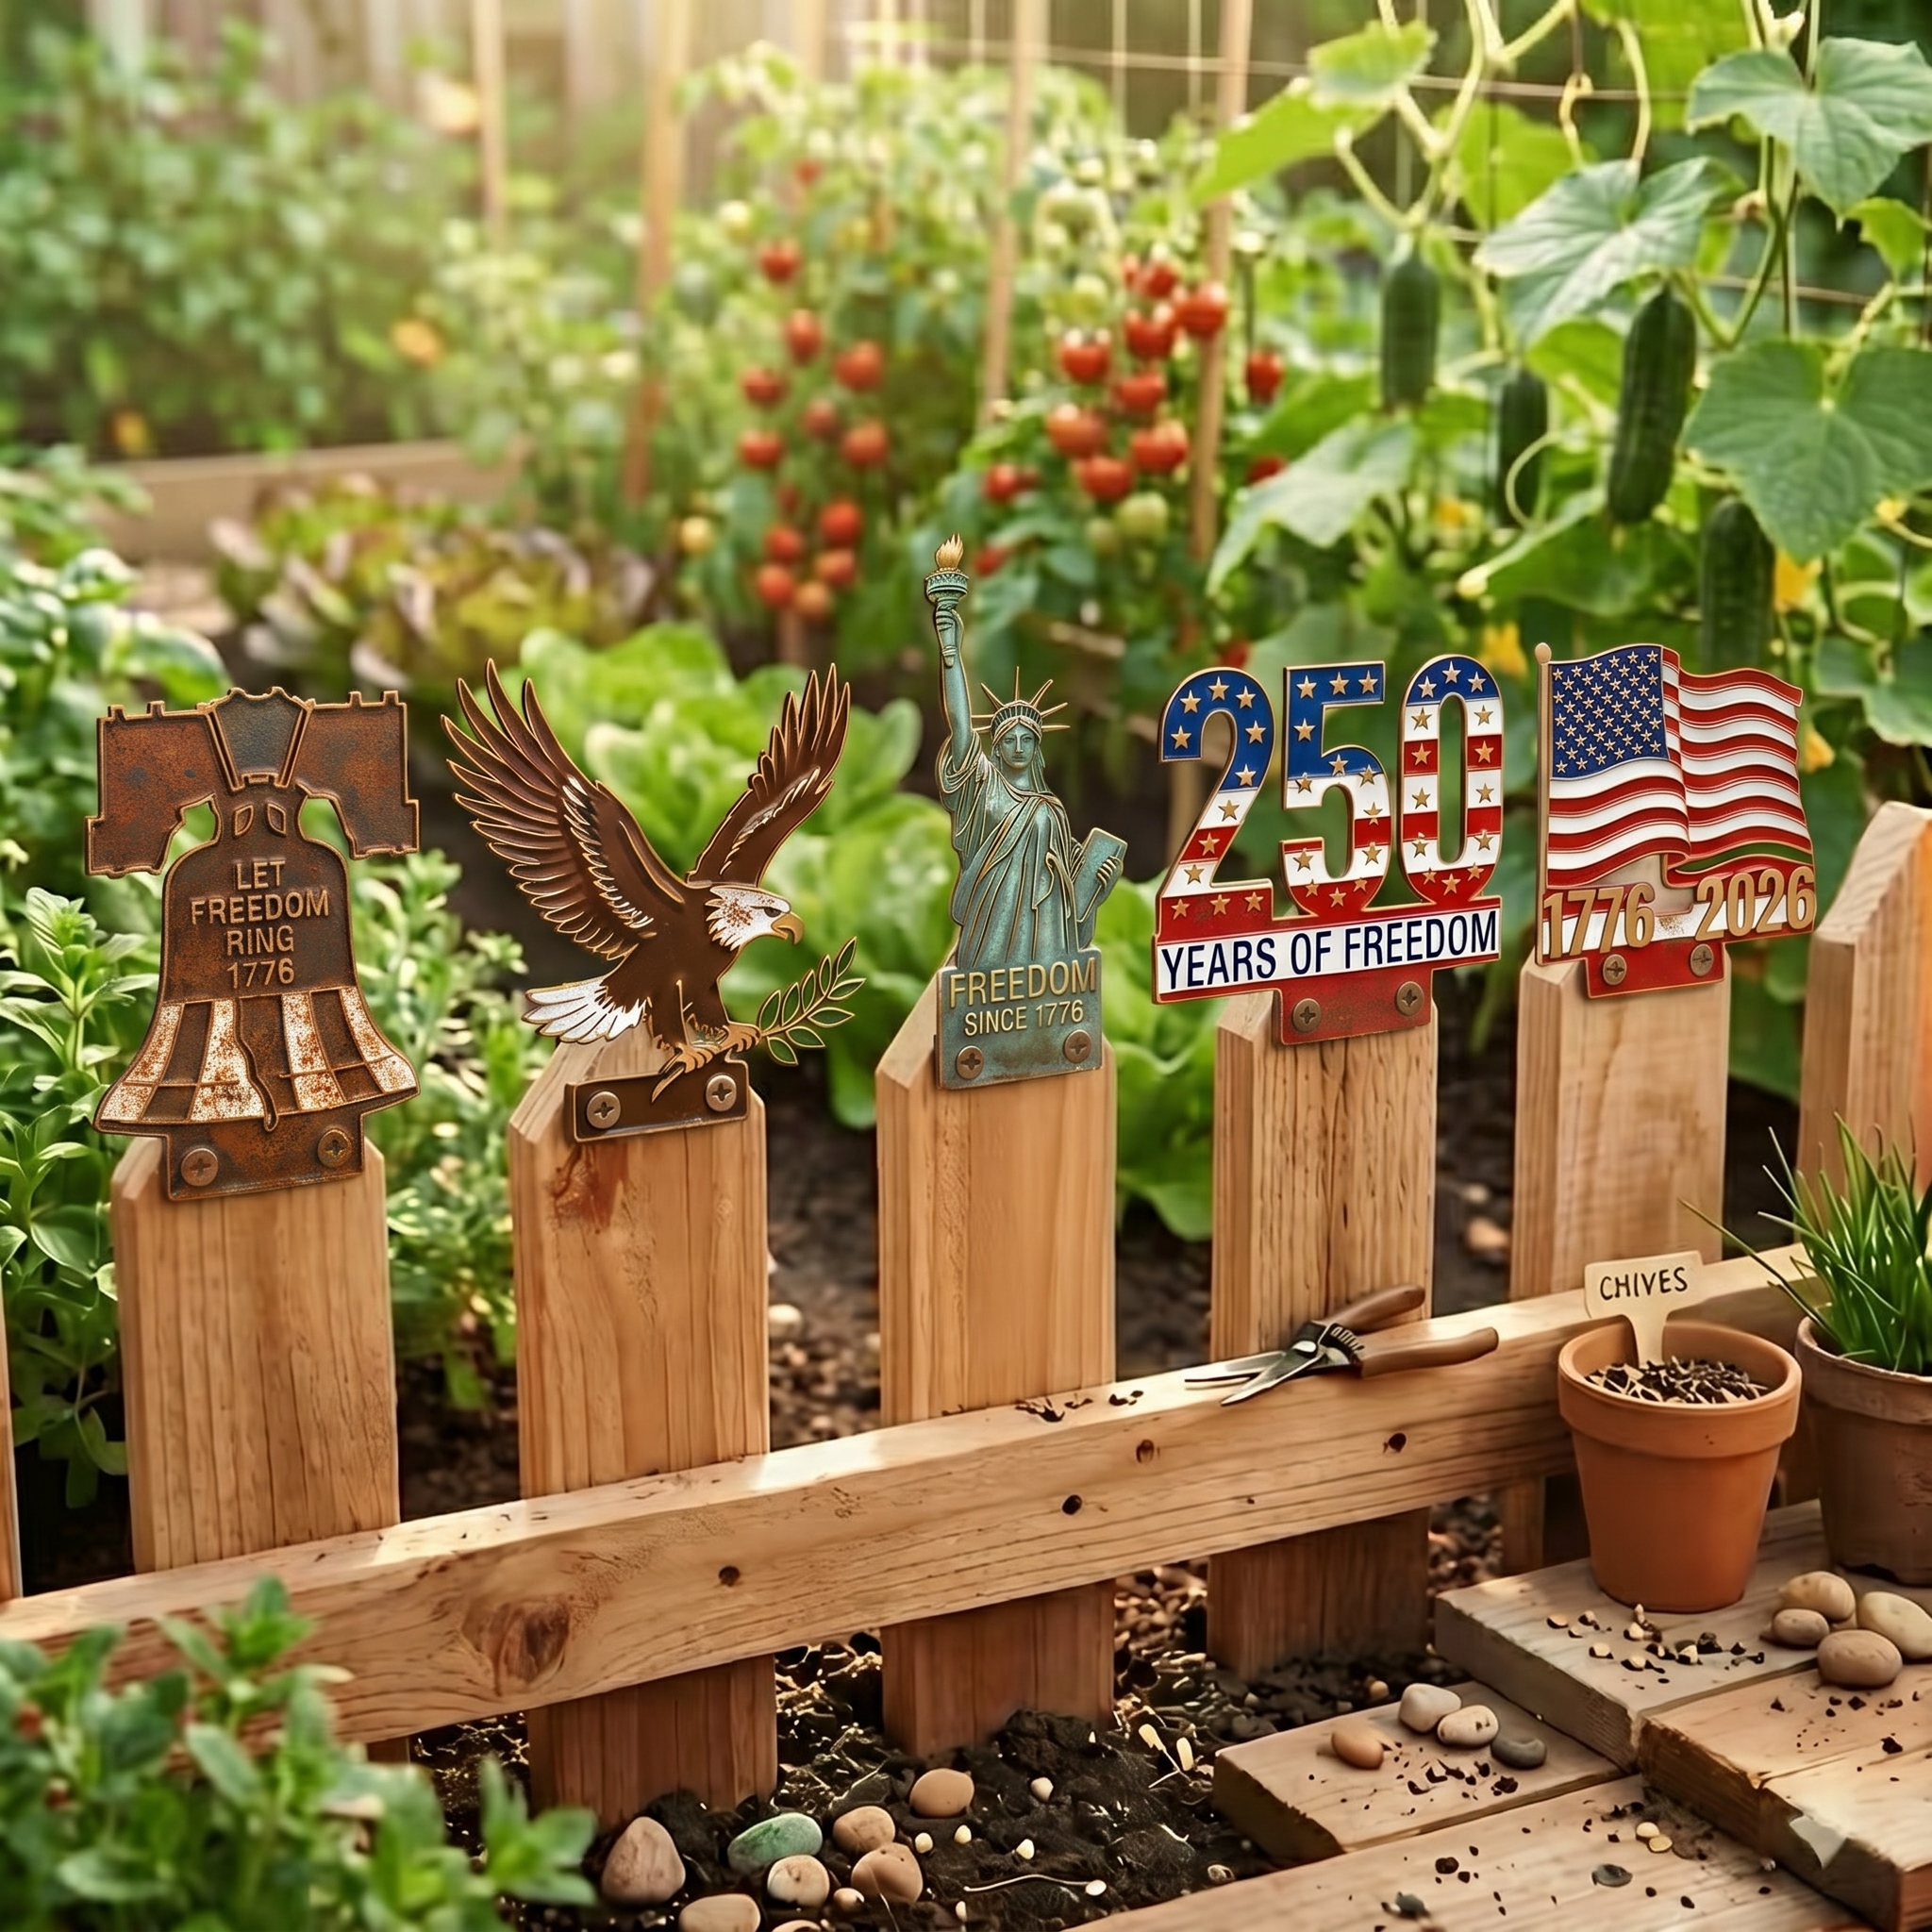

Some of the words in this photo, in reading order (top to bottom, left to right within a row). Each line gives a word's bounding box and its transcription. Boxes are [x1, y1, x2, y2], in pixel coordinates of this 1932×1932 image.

[1158, 654, 1504, 923] 250
[236, 860, 286, 891] LET
[191, 890, 330, 925] FREEDOM
[1543, 882, 1656, 958] 1776
[1694, 865, 1816, 941] 2026
[226, 924, 295, 957] RING
[1161, 937, 1277, 991] YEARS
[1291, 930, 1332, 975] OF
[1344, 910, 1497, 970] FREEDOM
[226, 958, 295, 989] 1776
[949, 957, 1096, 1008] FREEDOM
[964, 1006, 1027, 1037] SINCE
[1035, 999, 1084, 1028] 1776
[1600, 1266, 1689, 1301] CHIVES
